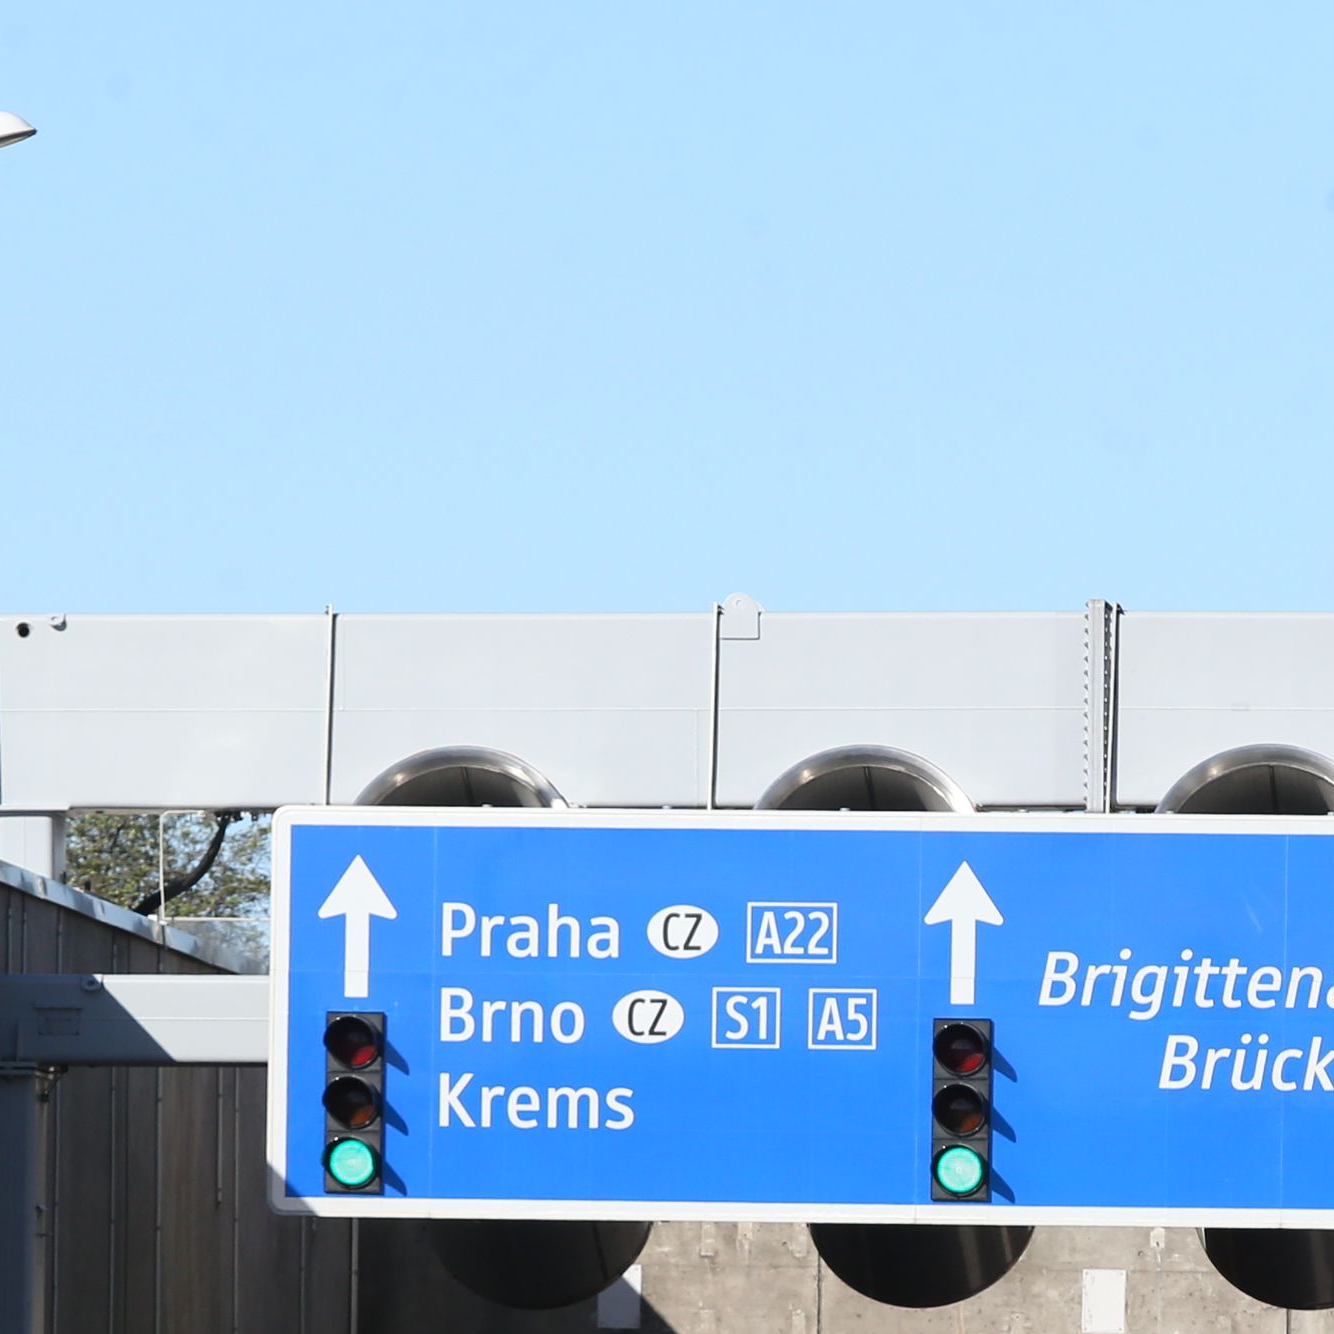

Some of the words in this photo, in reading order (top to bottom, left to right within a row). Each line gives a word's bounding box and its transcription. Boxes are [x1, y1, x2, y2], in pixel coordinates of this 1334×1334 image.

[441, 902, 620, 958] Praha
[662, 912, 703, 951] CZ
[754, 910, 830, 955] A22
[440, 987, 585, 1044] Brno
[627, 998, 668, 1037] CZ
[724, 995, 768, 1040] S1
[817, 997, 868, 1041] A5
[439, 1072, 635, 1130] Krems
